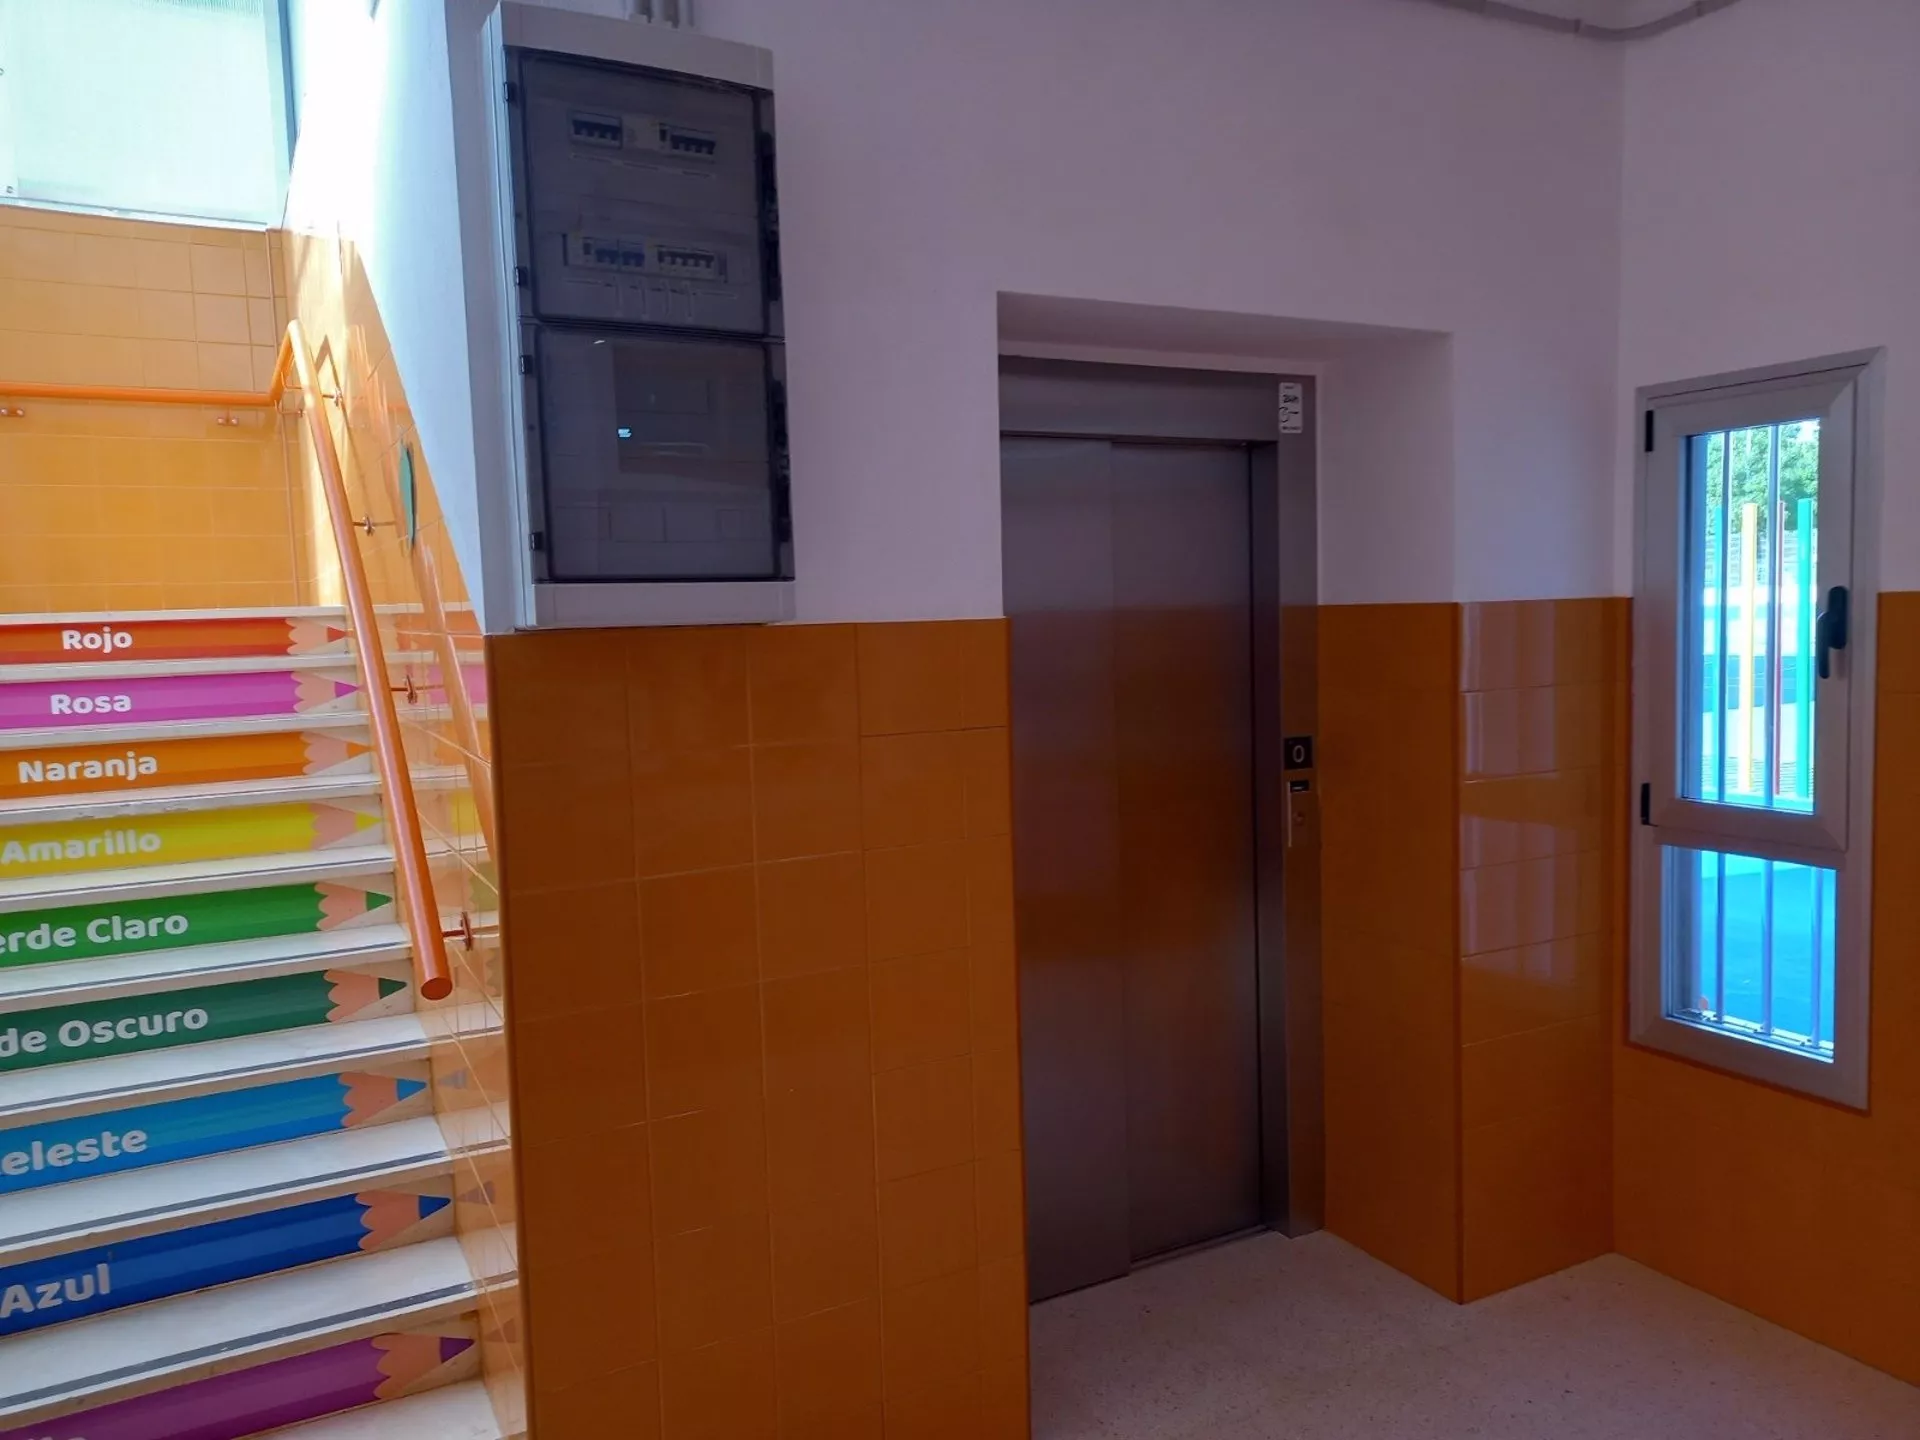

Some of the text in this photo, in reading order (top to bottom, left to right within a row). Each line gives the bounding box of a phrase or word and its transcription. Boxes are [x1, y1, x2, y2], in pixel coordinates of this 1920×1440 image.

[62, 626, 133, 654] Rojo
[50, 693, 132, 715] Rosa
[18, 751, 158, 783] Naranja
[0, 829, 162, 865] Amarillo
[0, 913, 189, 954] rde Claro
[58, 1008, 209, 1048] Oscuro
[0, 1129, 148, 1176] eleste
[0, 1263, 111, 1319] Azul
